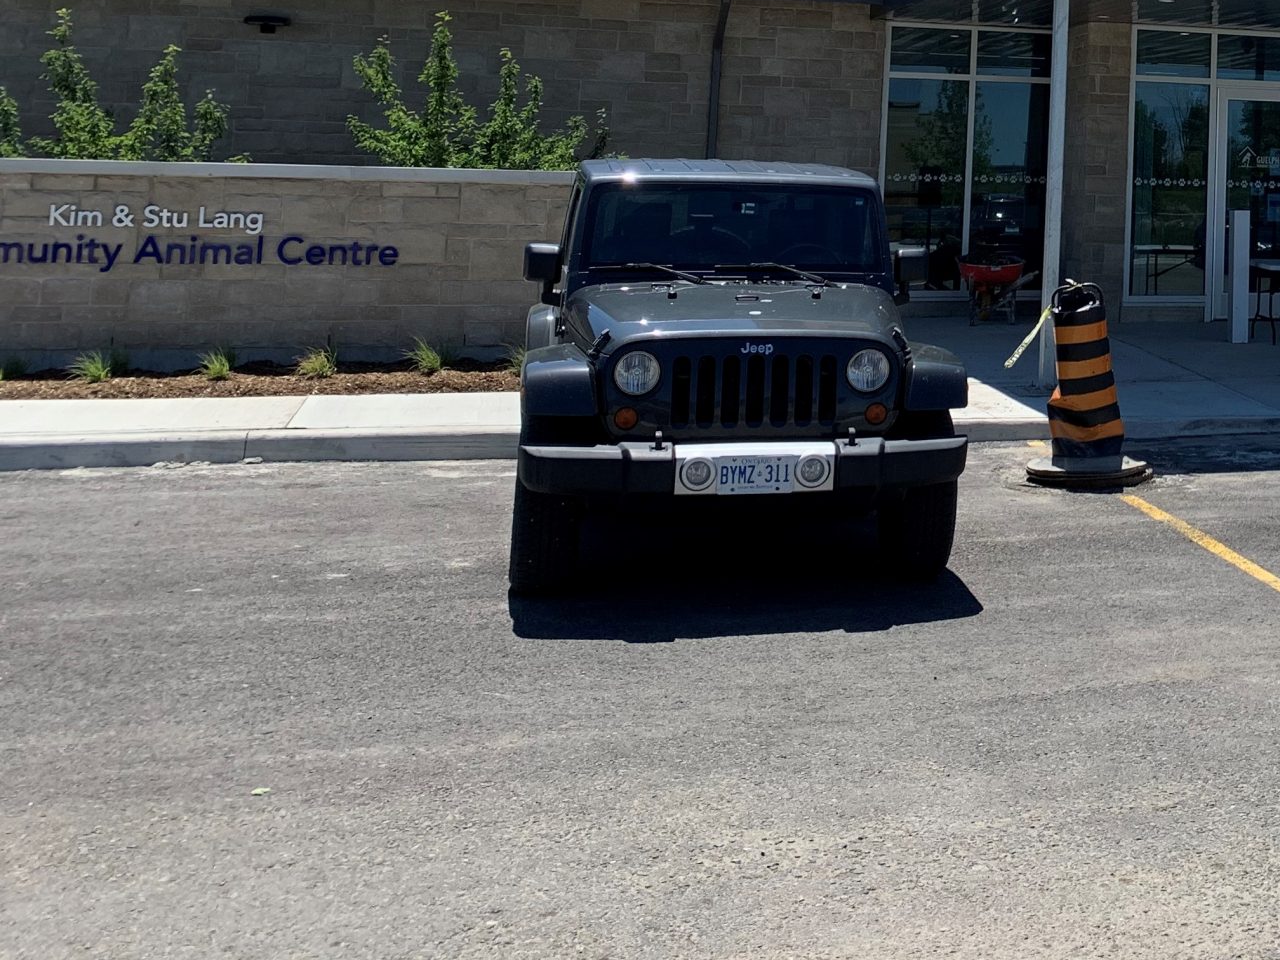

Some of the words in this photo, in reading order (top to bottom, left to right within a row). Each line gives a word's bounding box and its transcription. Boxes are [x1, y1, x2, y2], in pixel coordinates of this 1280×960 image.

[49, 204, 102, 227] Kim
[112, 205, 134, 227] &
[143, 205, 188, 228] Stu
[199, 206, 263, 235] Lang
[133, 234, 263, 265] Animal
[277, 236, 399, 266] Centre
[740, 342, 774, 355] Jeep
[720, 464, 756, 484] BYMZ
[764, 463, 790, 483] 311
